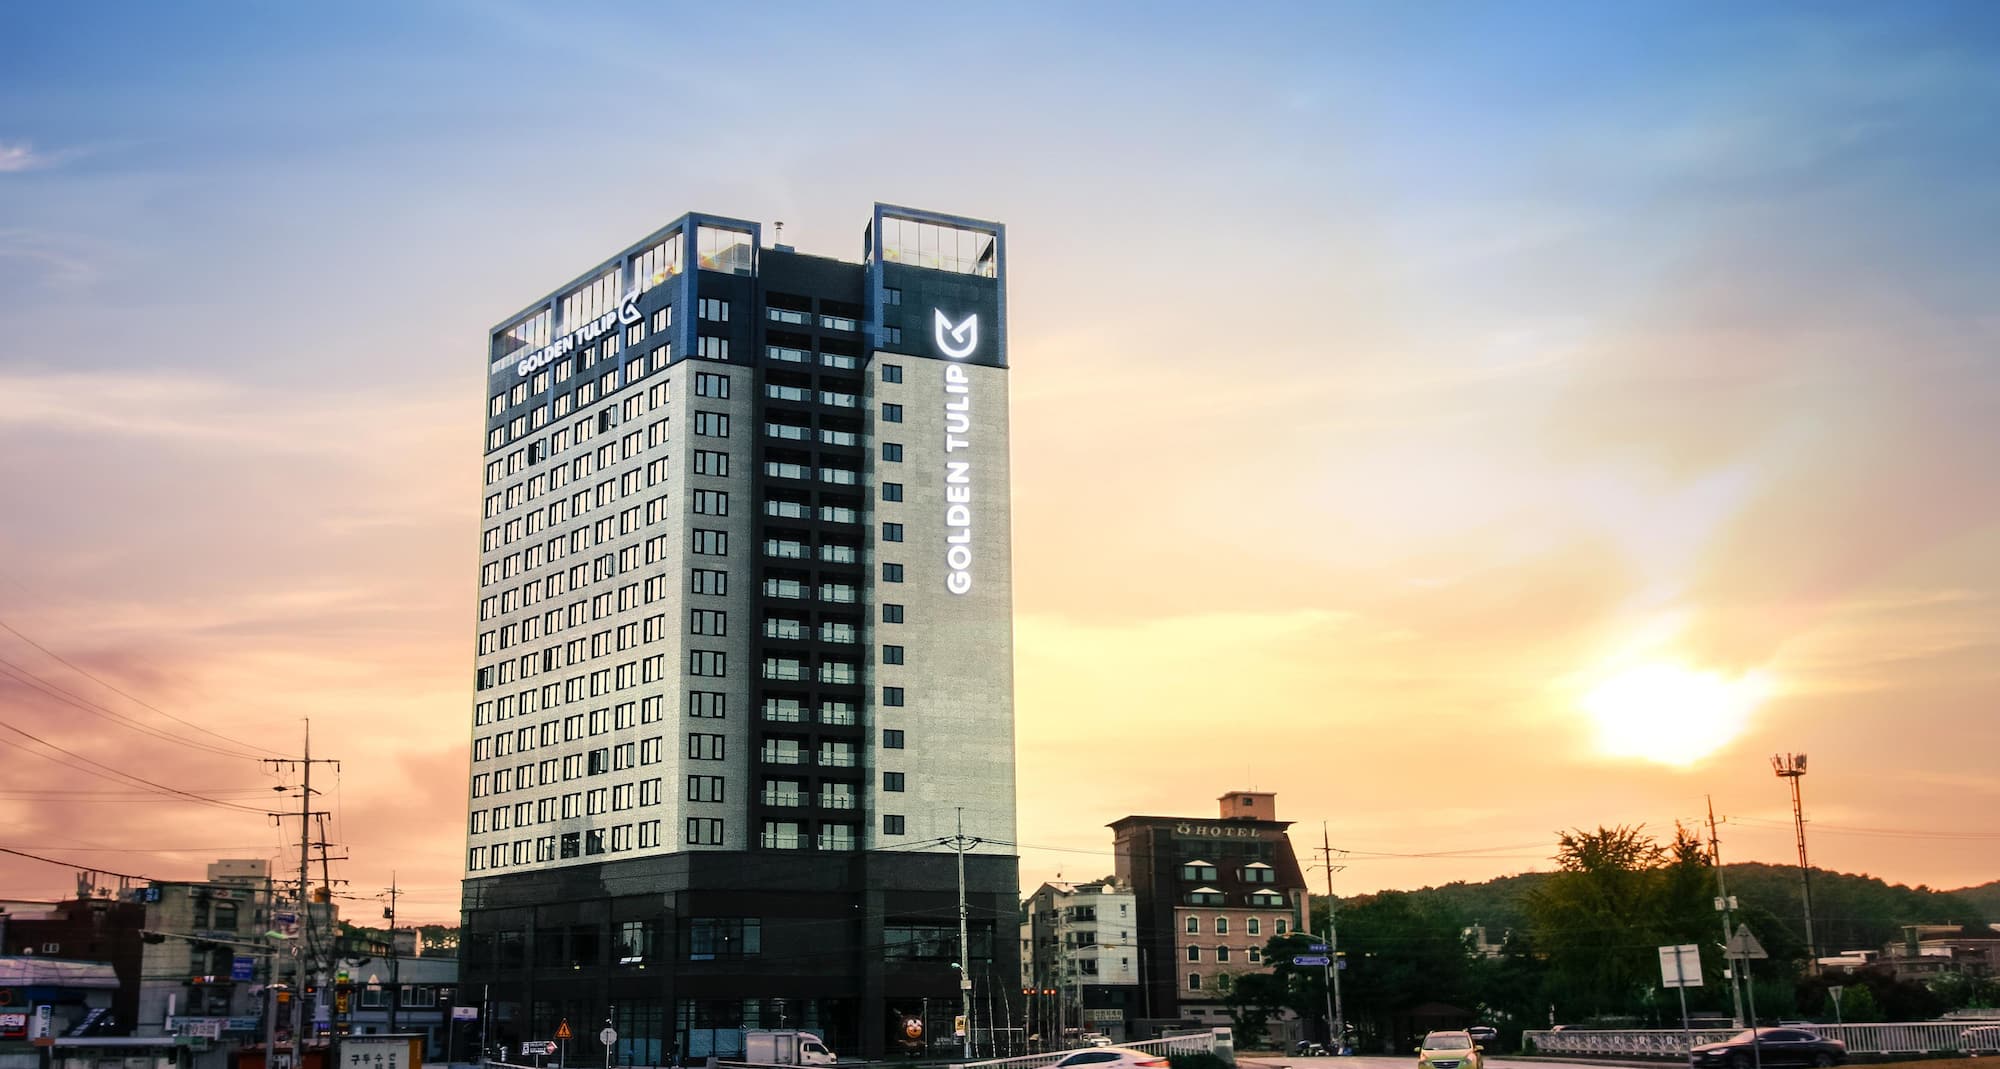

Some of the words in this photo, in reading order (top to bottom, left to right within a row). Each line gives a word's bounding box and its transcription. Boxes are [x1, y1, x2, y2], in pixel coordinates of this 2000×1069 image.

[518, 335, 573, 376] GOLDEN
[576, 312, 617, 345] TULIP
[946, 365, 969, 452] TULIP
[947, 462, 971, 594] GOLDEN
[1195, 826, 1260, 838] HOTEL
